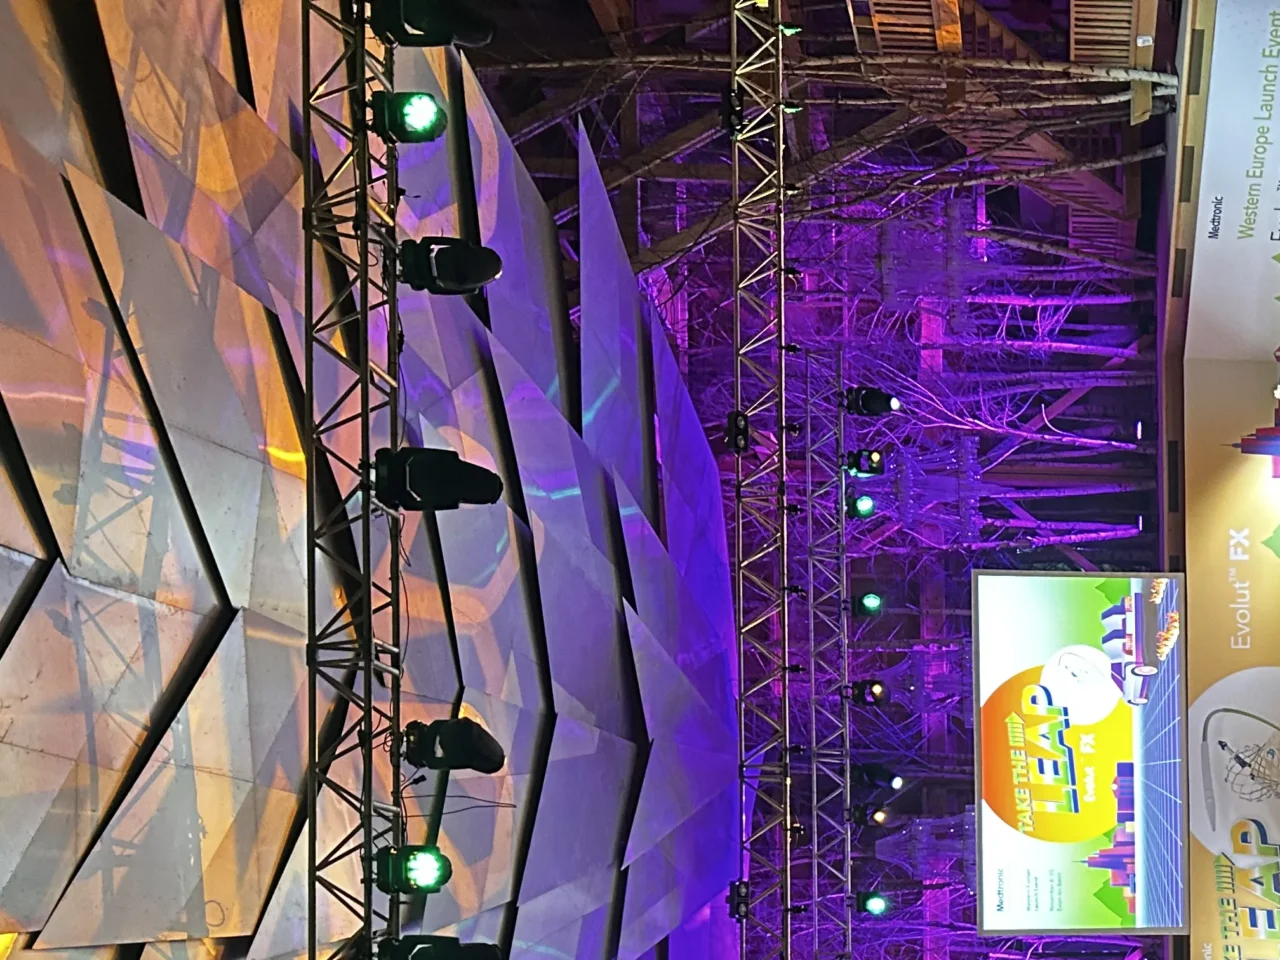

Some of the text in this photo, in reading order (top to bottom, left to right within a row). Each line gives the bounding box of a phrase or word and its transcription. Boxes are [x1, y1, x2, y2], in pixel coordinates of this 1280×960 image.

[1253, 64, 1279, 120] Launch
[1245, 125, 1273, 179] Europe
[1207, 196, 1224, 239] Medtronic
[1237, 183, 1262, 240] Western
[1229, 527, 1250, 561] FX
[1021, 684, 1080, 814] LEAP
[1080, 732, 1096, 754] FX
[1010, 749, 1035, 833] TAKE THE
[996, 868, 1004, 912] Medtronic
[1218, 897, 1239, 939] THE
